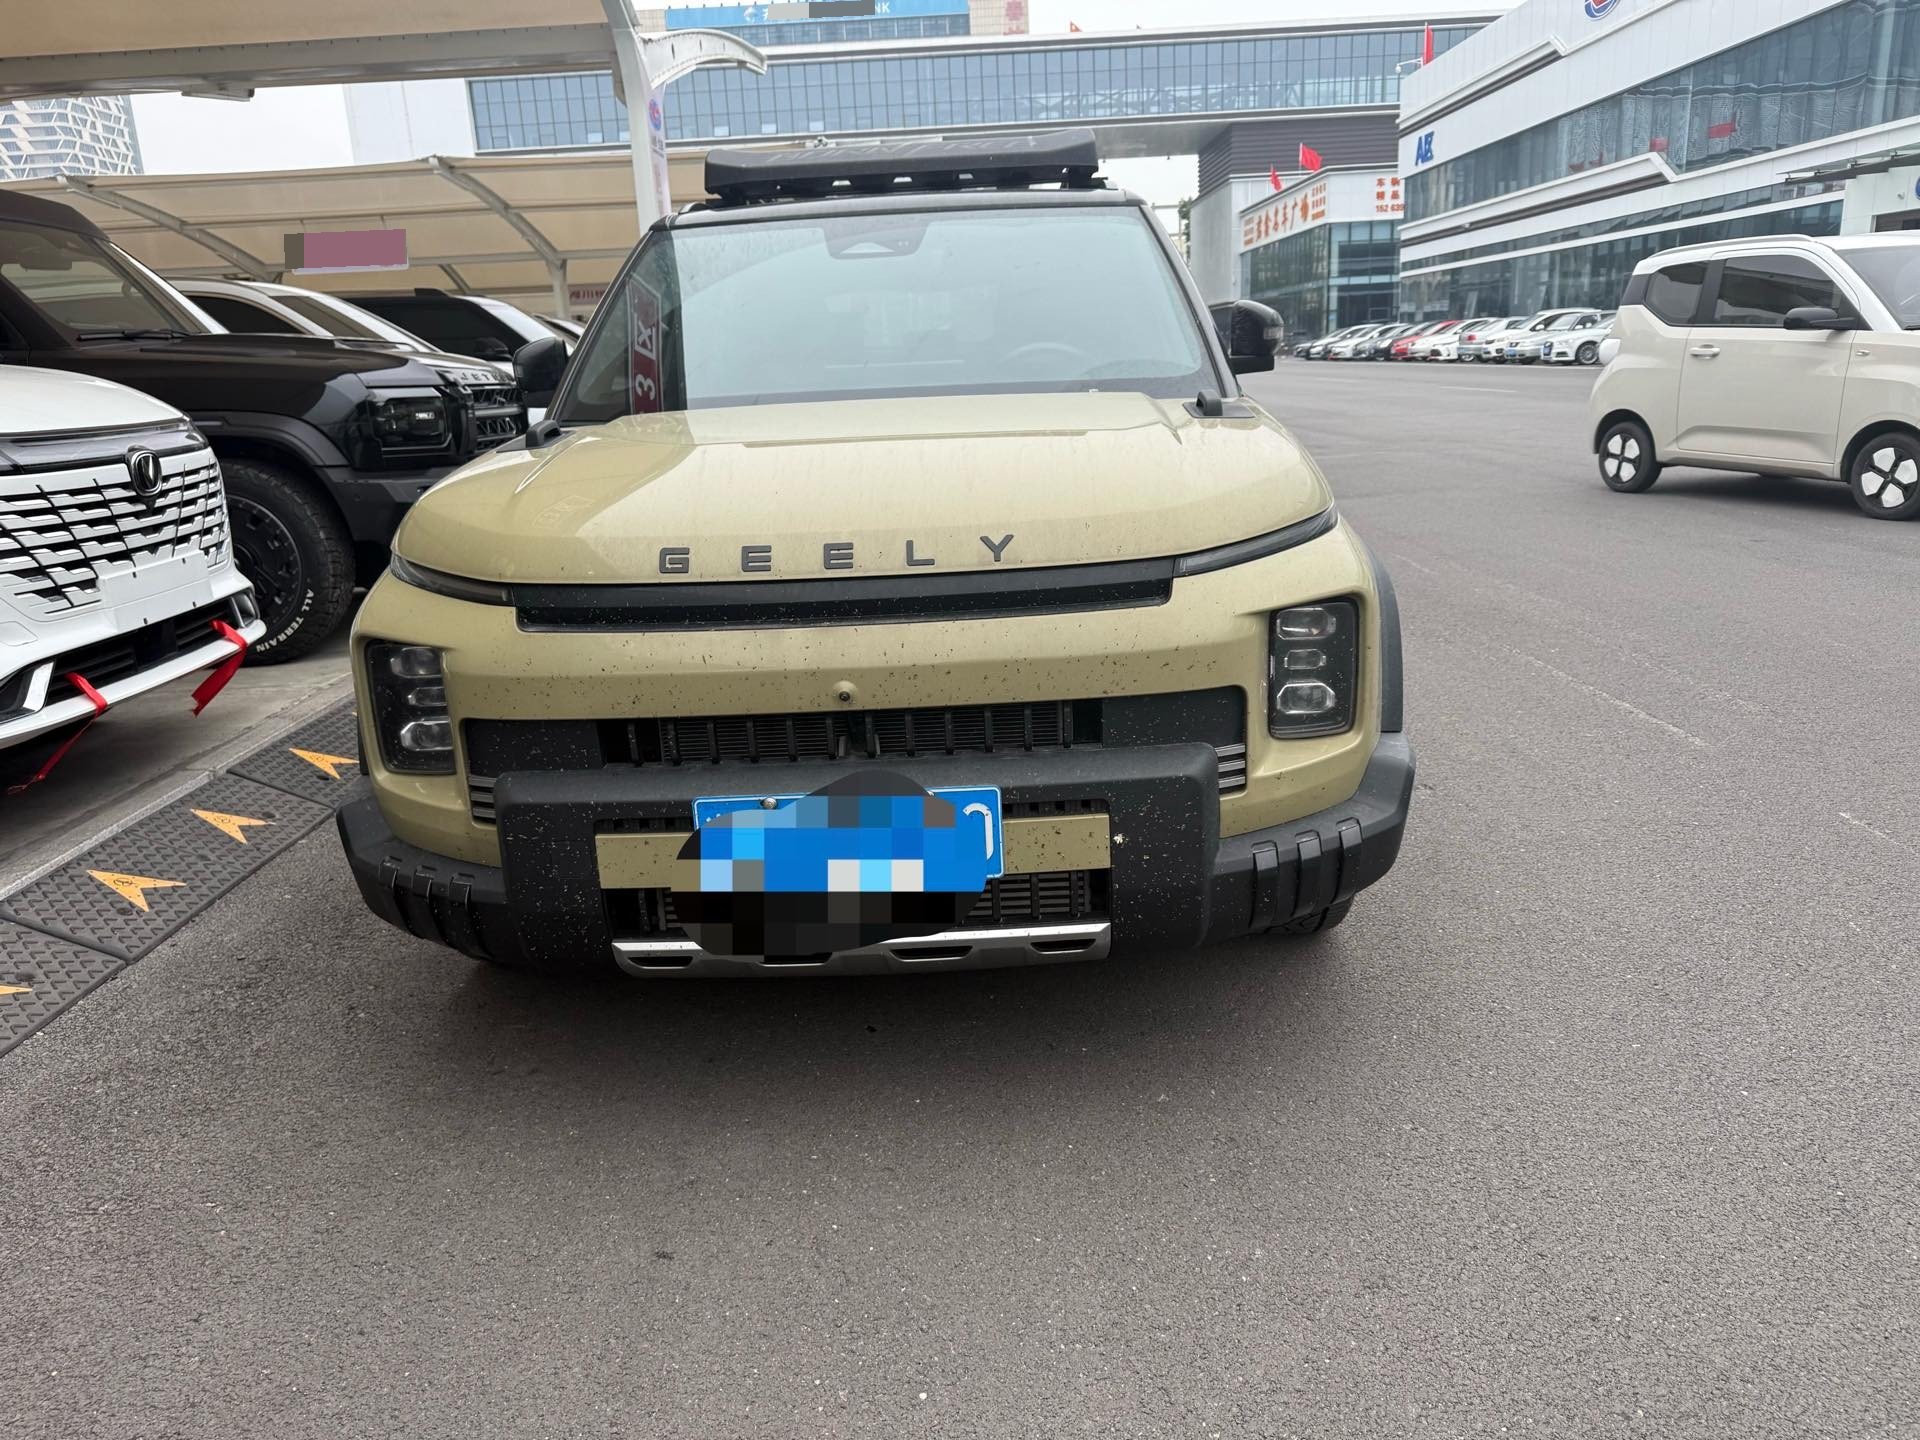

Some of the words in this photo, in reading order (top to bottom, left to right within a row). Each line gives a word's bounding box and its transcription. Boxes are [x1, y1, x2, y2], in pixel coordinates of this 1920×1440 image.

[659, 534, 1014, 574] GEELY
[301, 588, 315, 612] ALL
[256, 616, 304, 653] TERRAIN
